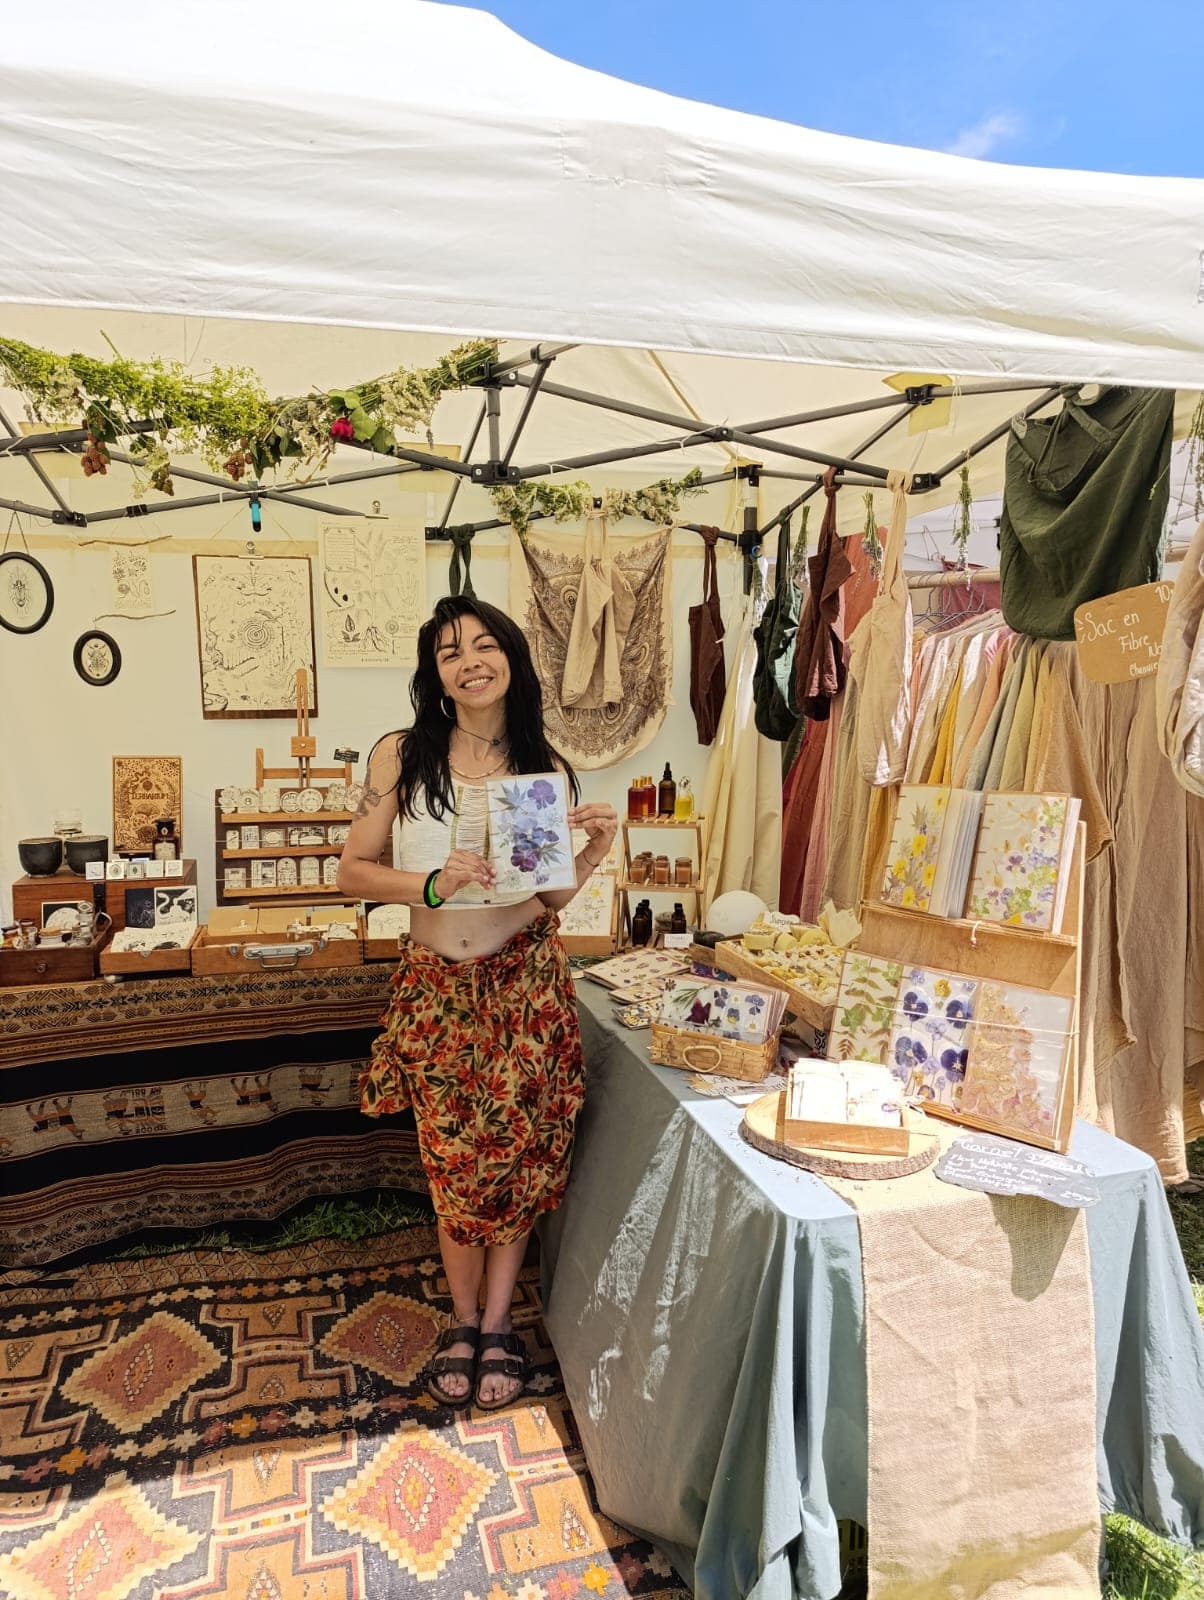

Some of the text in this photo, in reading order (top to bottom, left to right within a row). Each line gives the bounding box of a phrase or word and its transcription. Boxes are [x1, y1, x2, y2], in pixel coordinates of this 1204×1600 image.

[1085, 612, 1140, 642] Sac en
[1118, 632, 1150, 655] Fibre
